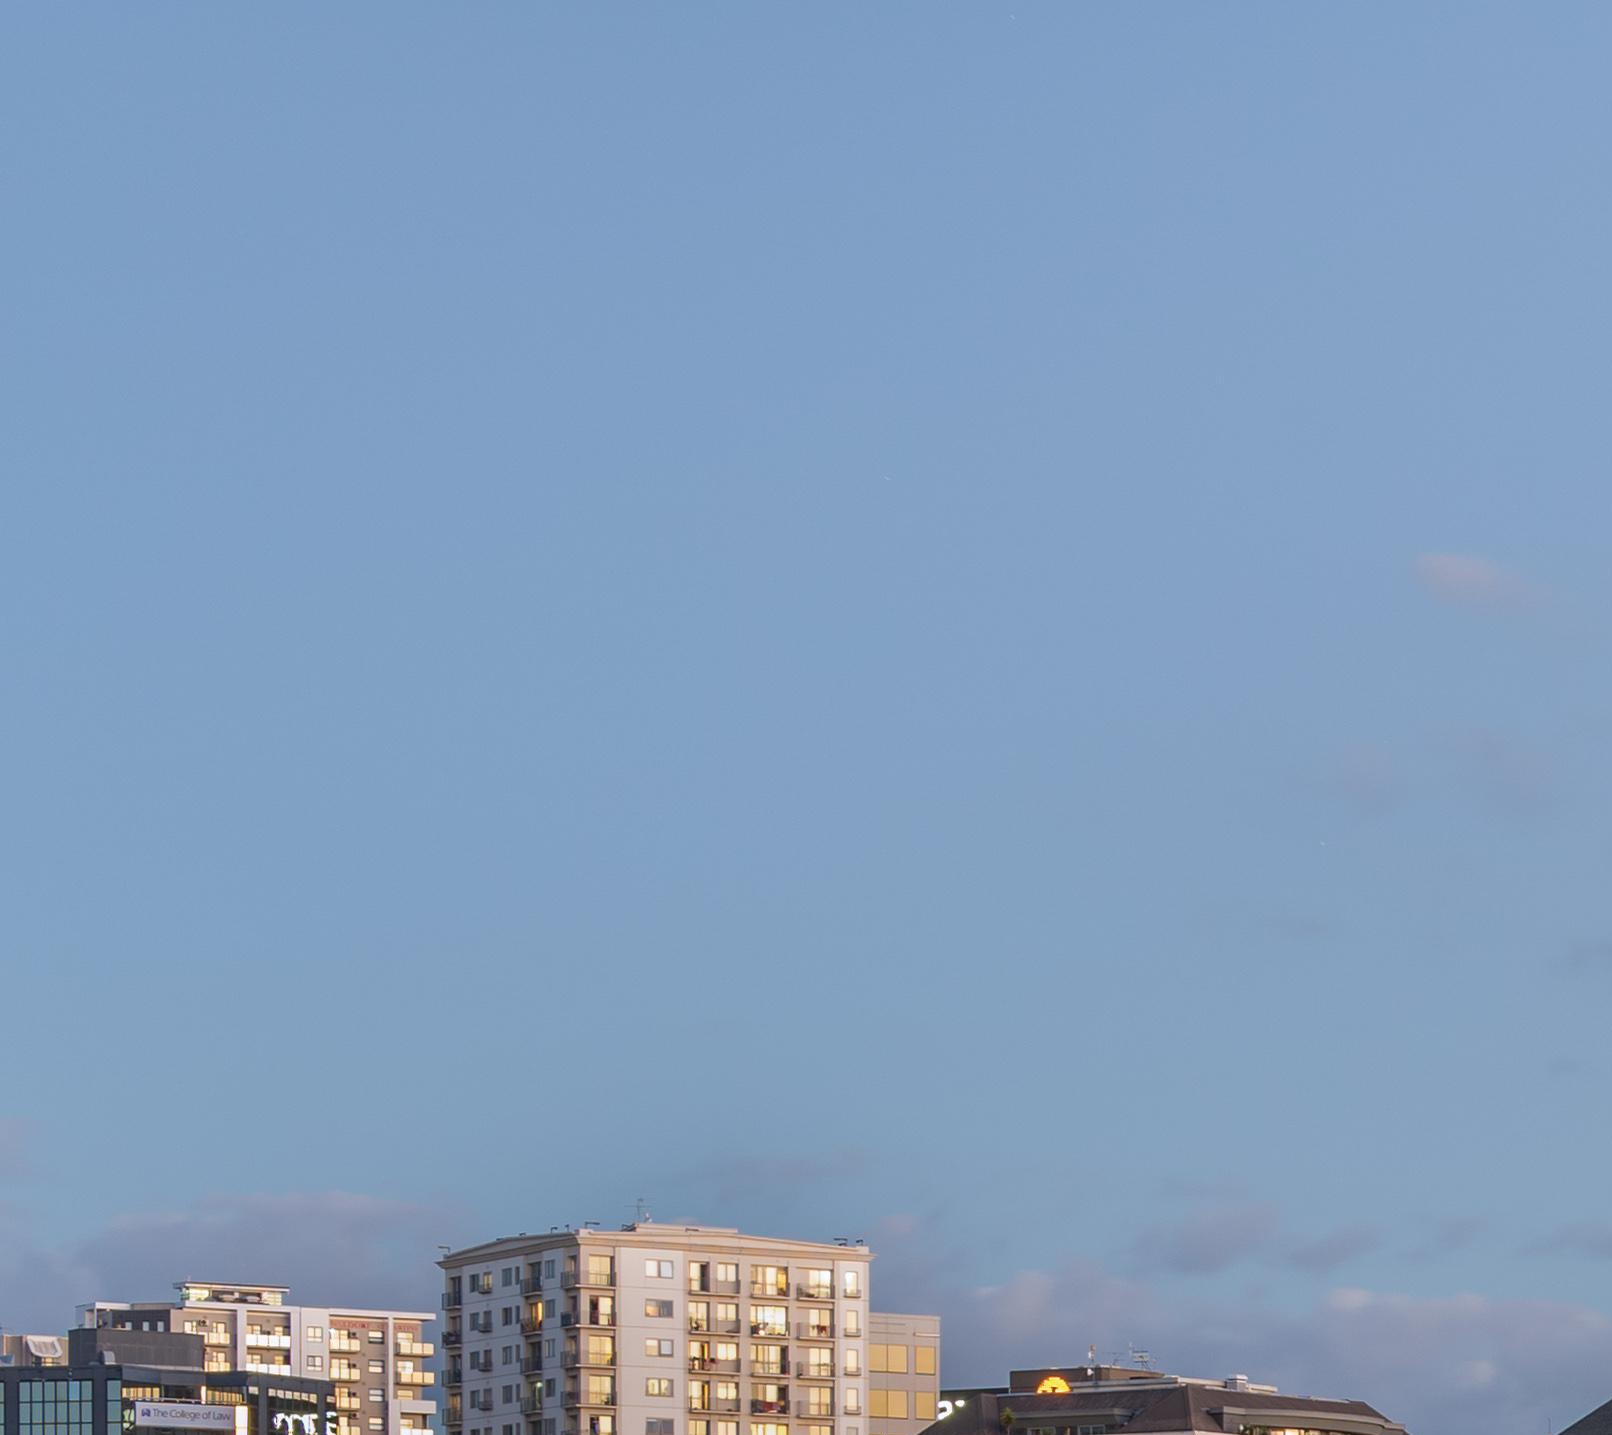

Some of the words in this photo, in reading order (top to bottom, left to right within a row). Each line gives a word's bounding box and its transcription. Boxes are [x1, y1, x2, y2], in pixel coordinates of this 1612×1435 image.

[153, 1408, 168, 1418] The
[170, 1409, 200, 1421] College
[202, 1410, 211, 1419] of
[213, 1412, 231, 1421] Law
